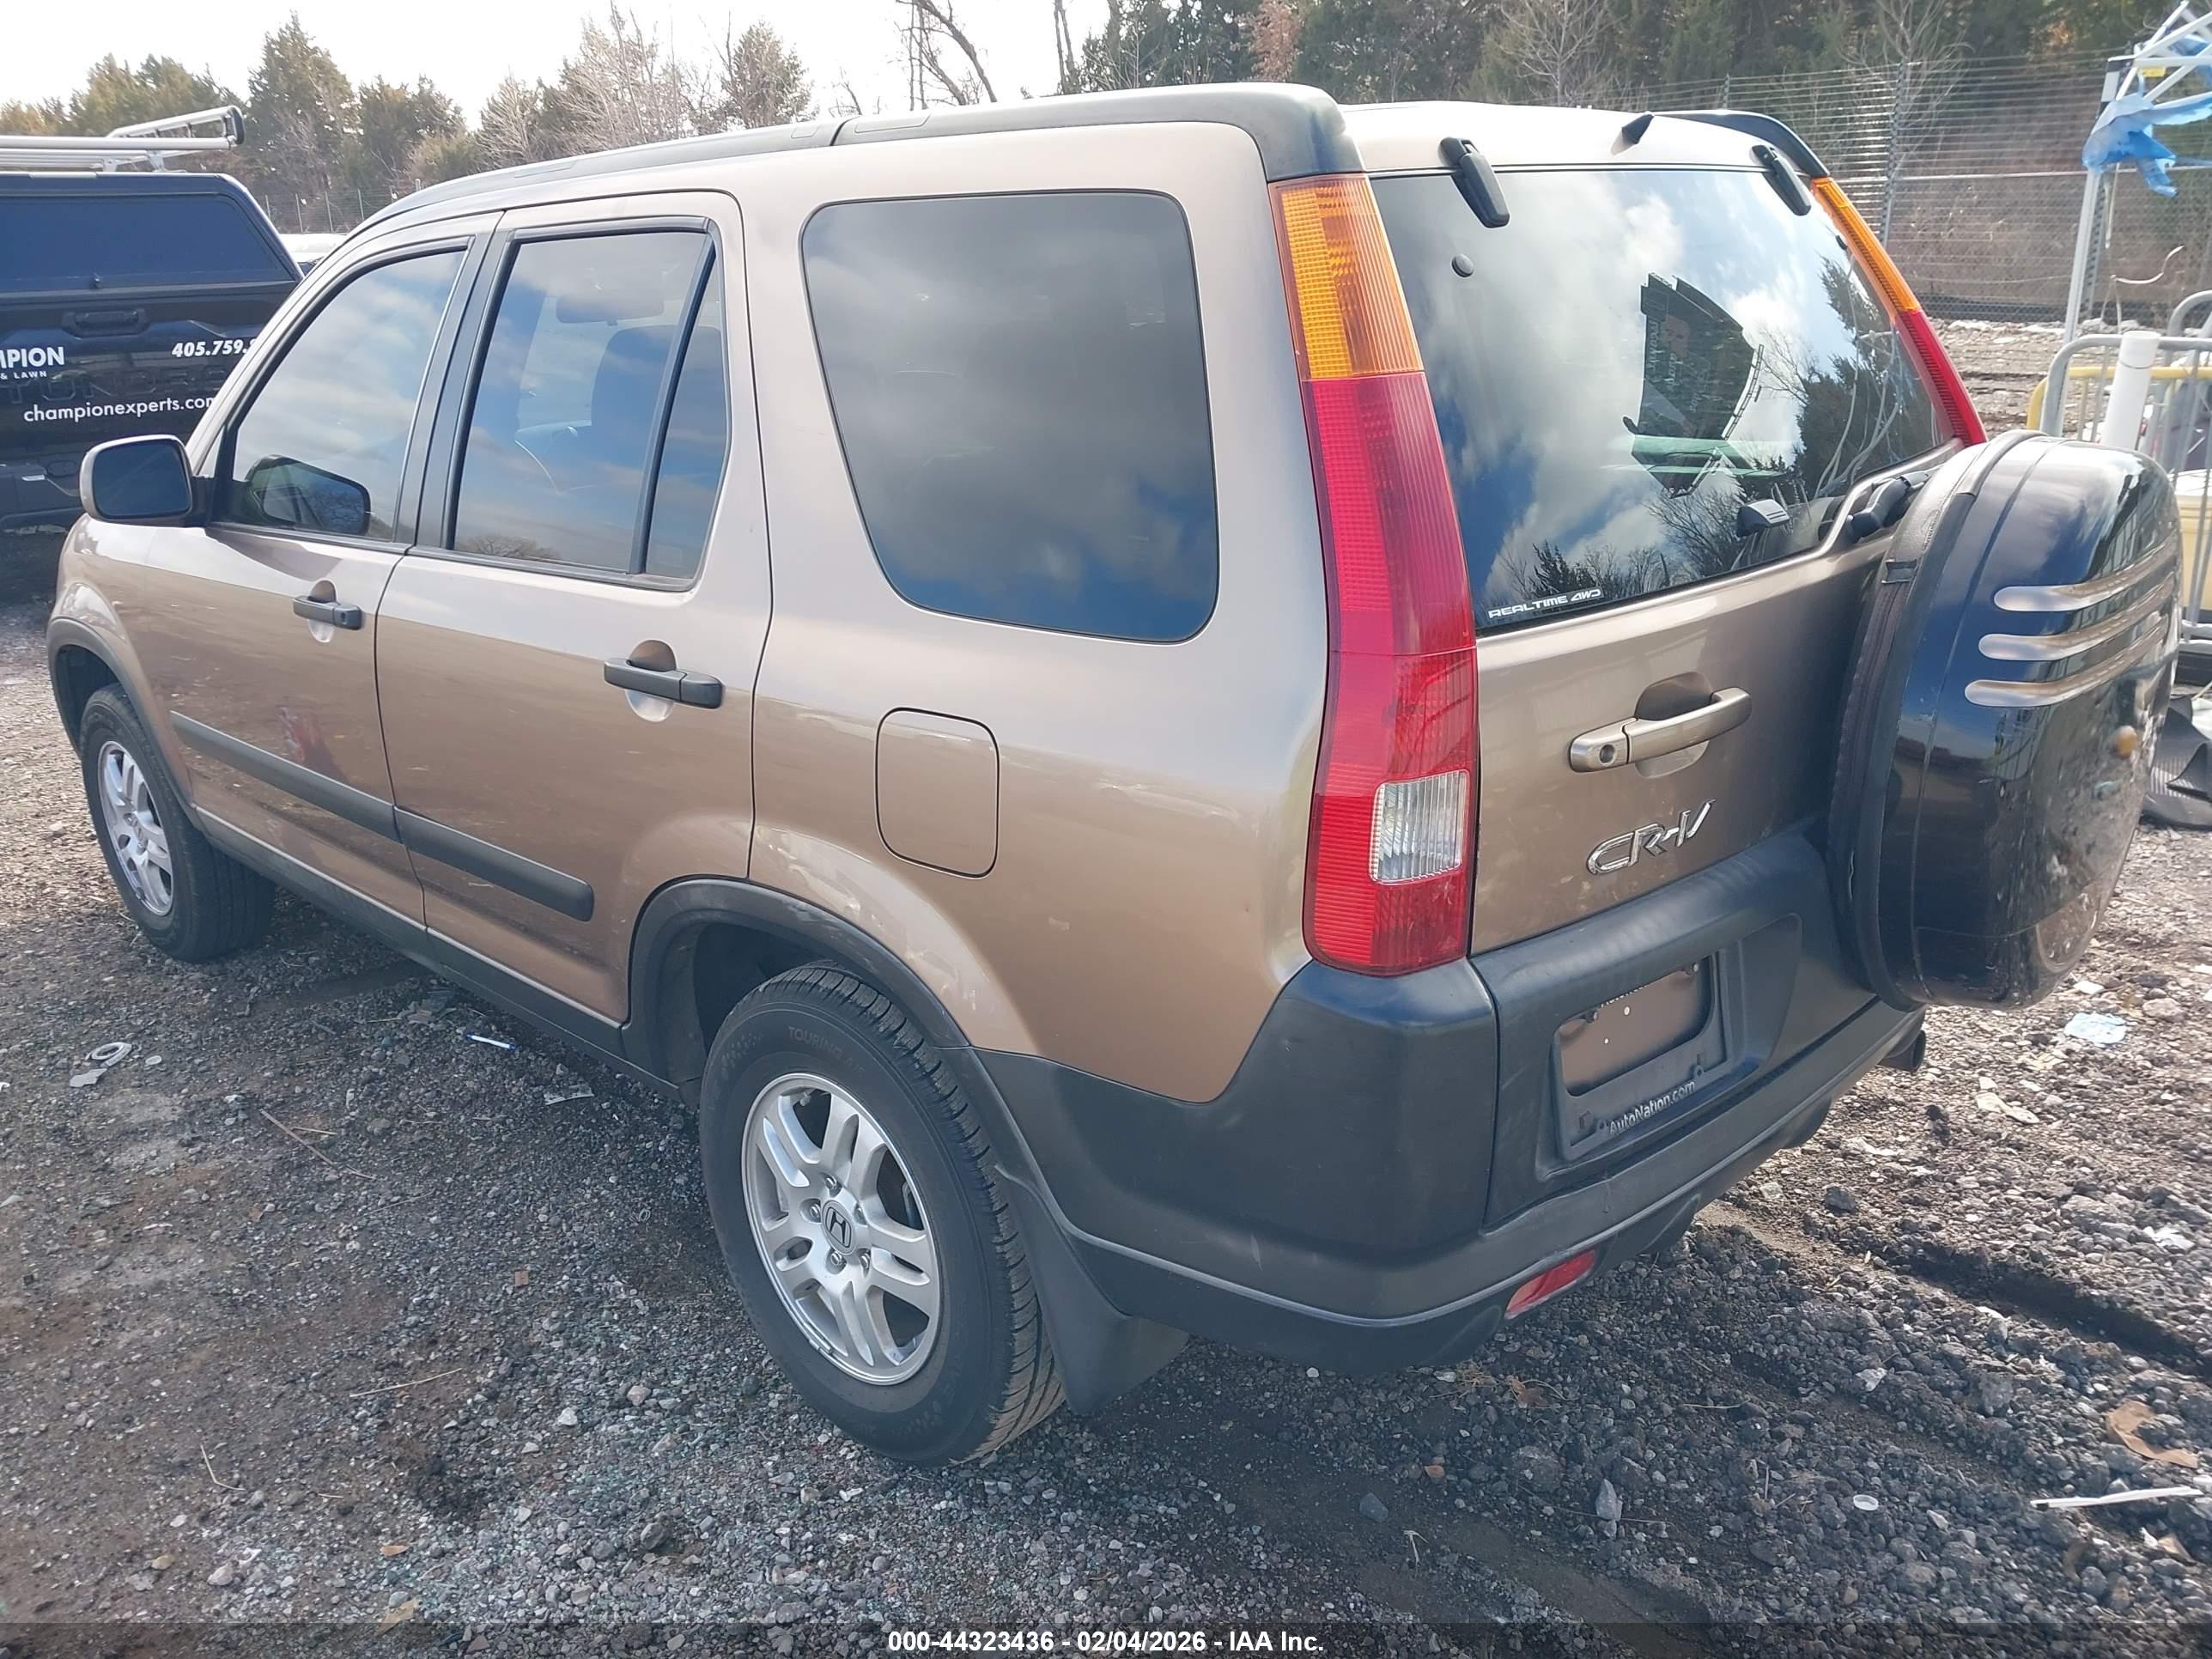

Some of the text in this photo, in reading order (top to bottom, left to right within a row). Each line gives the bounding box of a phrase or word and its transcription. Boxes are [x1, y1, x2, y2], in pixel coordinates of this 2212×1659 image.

[1488, 588, 1601, 618] REALTIME 4WD
[1587, 799, 1717, 875] CR-V
[1608, 1080, 1695, 1135] AutoNation.com
